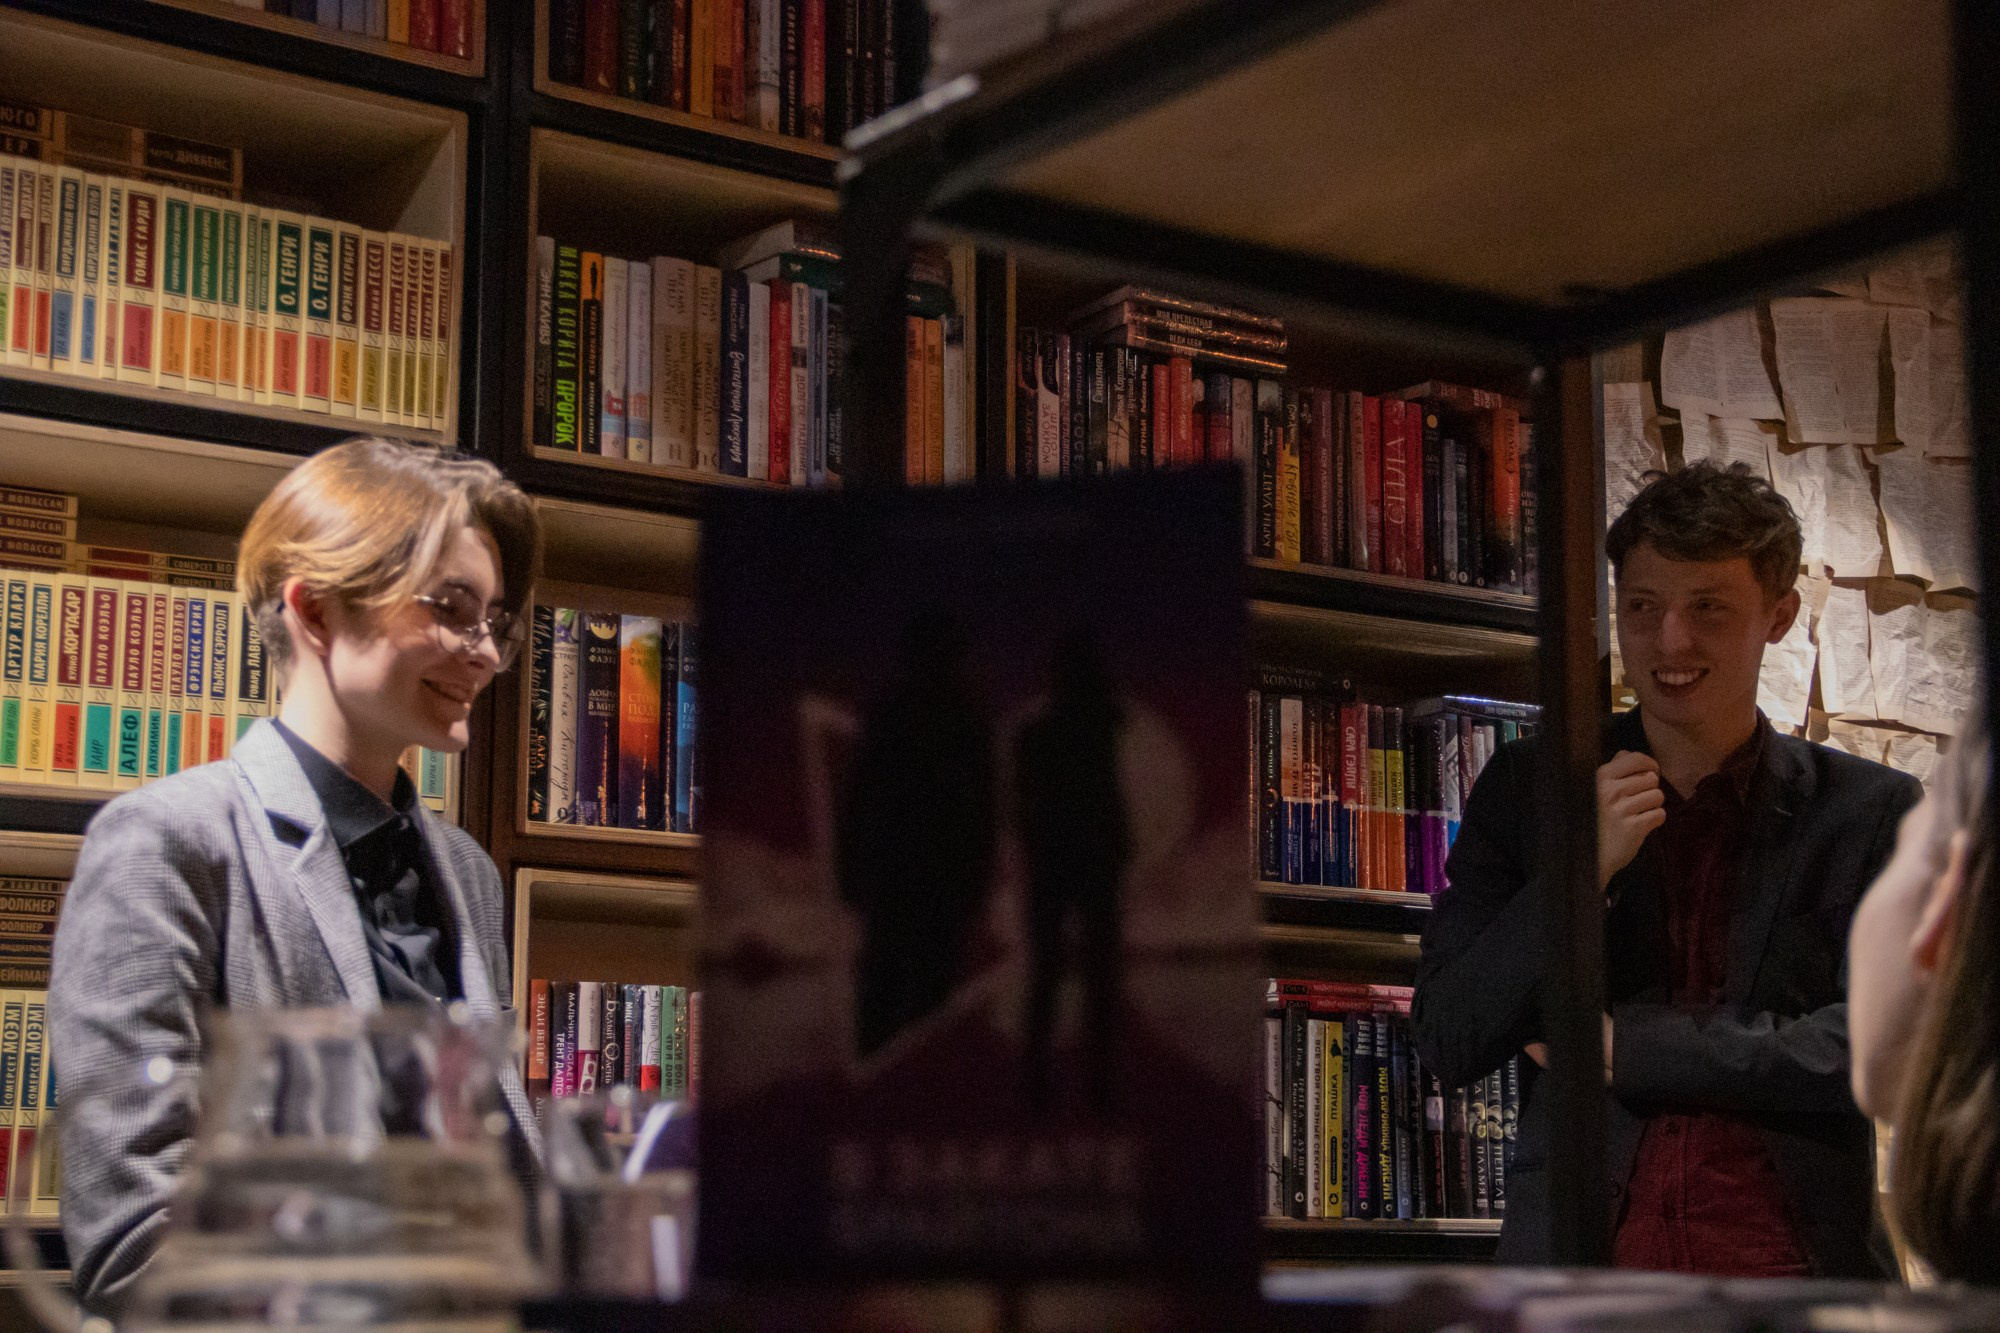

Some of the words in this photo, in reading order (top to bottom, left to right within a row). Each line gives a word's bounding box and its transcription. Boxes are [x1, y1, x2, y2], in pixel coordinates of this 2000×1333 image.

[0, 169, 13, 232] ВОННЕГУТ
[20, 173, 34, 220] ВУДХАУС
[41, 177, 53, 224] ВУДХАУС
[64, 183, 76, 210] ВУЛФ
[87, 190, 100, 216] ВУЛФ
[108, 192, 121, 242] ГАМСУН
[135, 199, 150, 240] ГАРДИ
[0, 235, 11, 267] КУРТ
[61, 212, 74, 273] ВИРДЖИНИЯ
[84, 218, 99, 278] ВИРДЖИНИЯ
[280, 235, 298, 286] ГЕНРИ
[343, 235, 355, 283] ГЕРБЕРТ
[107, 249, 119, 281] КНУТ
[134, 242, 148, 283] ТОМАС
[171, 256, 179, 289] ГАБРИЭЛЬ
[201, 264, 210, 298] ГАБРИЭЛЬ
[313, 241, 330, 291] ГЕНРИ
[368, 247, 382, 286] ГЕССЕ
[391, 250, 402, 289] ГЕССЕ
[408, 253, 418, 292] ГЕССЕ
[422, 256, 433, 294] ГЕССЕ
[226, 268, 234, 301] ГАБРИЭЛЬ
[246, 272, 255, 306] ГАБРИЭЛЬ
[260, 276, 268, 307] ГАБРИЭЛЬ
[279, 290, 297, 305] О.
[311, 295, 329, 310] О.
[343, 285, 353, 322] ФРЭНК
[539, 269, 552, 300] ЭНН
[369, 288, 381, 328] ГЕРМАН
[392, 292, 402, 331] ГЕРМАН
[408, 295, 418, 334] ГЕРМАН
[423, 297, 432, 337] ГЕРМАН
[539, 300, 551, 346] КЛИВЗ
[557, 307, 577, 369] КОРИТА
[1075, 351, 1083, 363] СИ
[1092, 351, 1104, 404] Сицилиец
[1113, 347, 1126, 392] Корлеоне
[1139, 364, 1149, 380] Рид
[555, 379, 576, 445] ПРОРОК
[795, 374, 806, 419] ДОЛГОЕ
[1041, 403, 1050, 421] ЗА
[1114, 393, 1125, 423] Семья
[795, 423, 806, 473] ПАДЕНИЕ
[1041, 421, 1050, 465] ОКНОМ
[1049, 412, 1058, 459] ШЕПОТ
[1139, 418, 1147, 457] ЛГУНЬИ
[1263, 471, 1273, 509] УАЙТ
[1385, 437, 1406, 524] СИЛА
[8, 493, 63, 508] МОПАССАН
[7, 517, 63, 533] МОПАССАН
[1263, 513, 1273, 547] КАРЕН
[6, 540, 63, 556] МОПАССАН
[173, 560, 214, 572] СОМЕРСЕТ
[172, 576, 212, 588] СОМЕРСЕТ
[9, 584, 25, 630] КЛАРК
[35, 590, 49, 640] КОРЕЛЛИ
[63, 591, 81, 655] КОРТАСАР
[96, 594, 112, 640] КОЭЛЬО
[128, 598, 143, 645] КОЭЛЬО
[152, 600, 166, 645] КОЭЛЬО
[171, 604, 185, 649] КОЭЛЬО
[190, 603, 203, 635] КРИК
[213, 609, 228, 655] КЭРРОЛЛ
[247, 619, 261, 668] ЛАВКРА
[7, 634, 22, 677] АРТУР
[33, 641, 47, 680] МАРИЯ
[67, 655, 79, 681] ХУЛИО
[95, 644, 109, 683] ПАУЛО
[127, 648, 140, 687] ПАУЛО
[150, 650, 164, 688] ПАУЛО
[170, 653, 183, 691] ПАУЛО
[189, 638, 202, 692] ФРЭНСИС
[212, 657, 226, 694] ЛЬЮИС
[251, 669, 260, 698] ГОВАРД
[559, 663, 575, 721] Оливия
[32, 707, 42, 736] САТАНЫ
[67, 715, 77, 758] КЛАССИКИ
[1345, 726, 1356, 752] САРА
[30, 737, 40, 765] СКОРБЬ
[55, 743, 64, 763] ИГРА
[91, 739, 104, 767] ЗАИР
[121, 714, 139, 771] АЛЕФ
[148, 714, 160, 771] АЛХИМИК
[536, 735, 547, 769] САРА
[429, 764, 437, 794] ПРИЗРАК
[1345, 754, 1357, 789] ГЭЙЛИ
[537, 993, 546, 1026] ЭНДИ
[567, 992, 576, 1039] МАЛЬЧИК
[605, 1000, 620, 1040] Белый
[624, 1001, 634, 1023] МИСС
[3, 1007, 21, 1054] МОЭМ
[25, 1009, 44, 1055] МОЭМ
[535, 1029, 546, 1064] ВЕЙЕР
[555, 1032, 566, 1060] ТРЕНТ
[665, 1034, 673, 1049] ЧТО
[4, 1055, 17, 1106] СОМЕРСЕТ
[27, 1055, 40, 1106] СОМЕРСЕТ
[554, 1061, 566, 1099] ДАЛТО
[566, 1042, 575, 1082] ГЛОТАЕТ
[604, 1041, 620, 1084] Олень
[1378, 1067, 1389, 1093] МОЯ
[1507, 1060, 1517, 1096] ИНЕЙ
[1313, 1091, 1321, 1140] ГРЯЗНЫЕ
[1330, 1074, 1339, 1120] ПТАШКА
[1358, 1084, 1369, 1111] МОЯ
[1355, 1113, 1370, 1148] ЛЕДИ
[1379, 1095, 1389, 1152] СКРОМНИЦА
[1297, 1138, 1305, 1177] ДУШИ
[1313, 1142, 1321, 1191] СЕКРЕТЫ
[1356, 1151, 1370, 1199] ДЖЕЙН
[1379, 1153, 1394, 1201] ДЖЕЙН
[1476, 1145, 1485, 1195] ПЛАМЯ
[1493, 1145, 1504, 1198] ПЕПЕЛ
